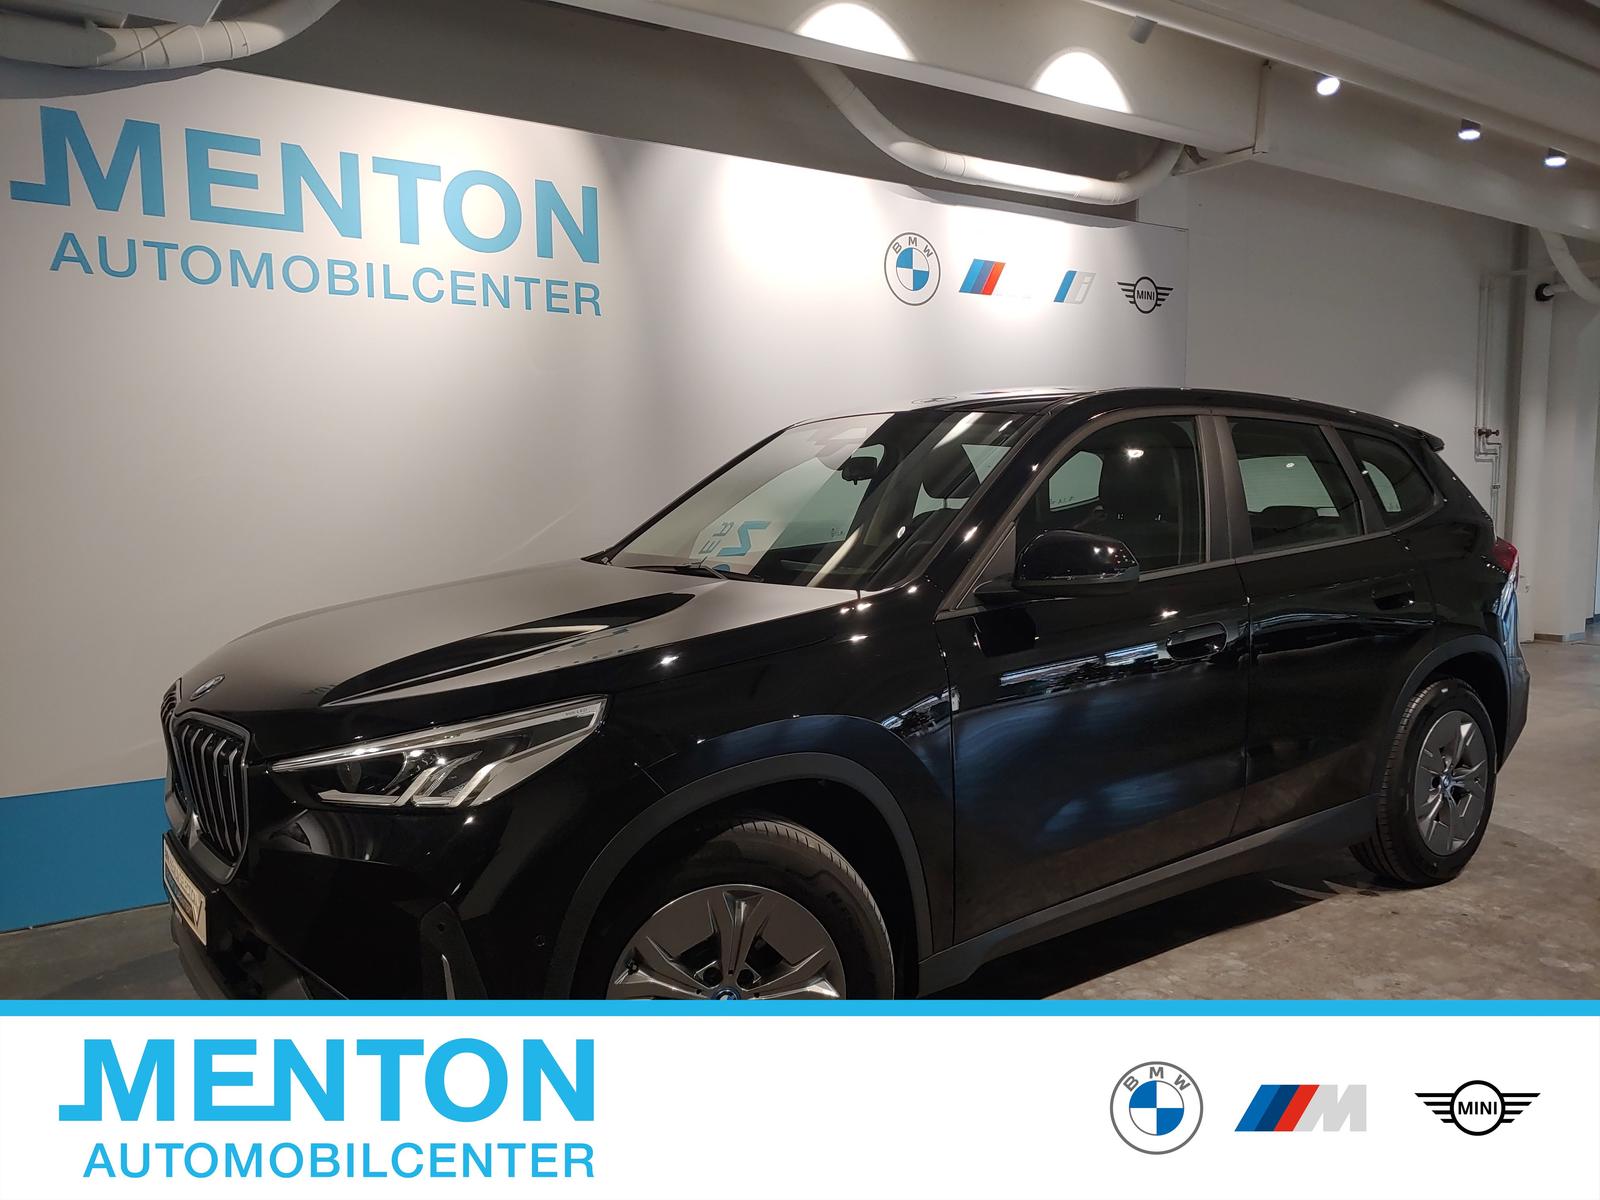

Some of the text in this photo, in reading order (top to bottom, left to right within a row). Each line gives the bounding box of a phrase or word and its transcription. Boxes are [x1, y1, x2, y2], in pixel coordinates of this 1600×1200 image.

[10, 105, 600, 263] MENTON
[892, 236, 933, 258] BMW
[50, 232, 602, 316] AUTOMOBILCENTER
[1136, 290, 1155, 301] MINI
